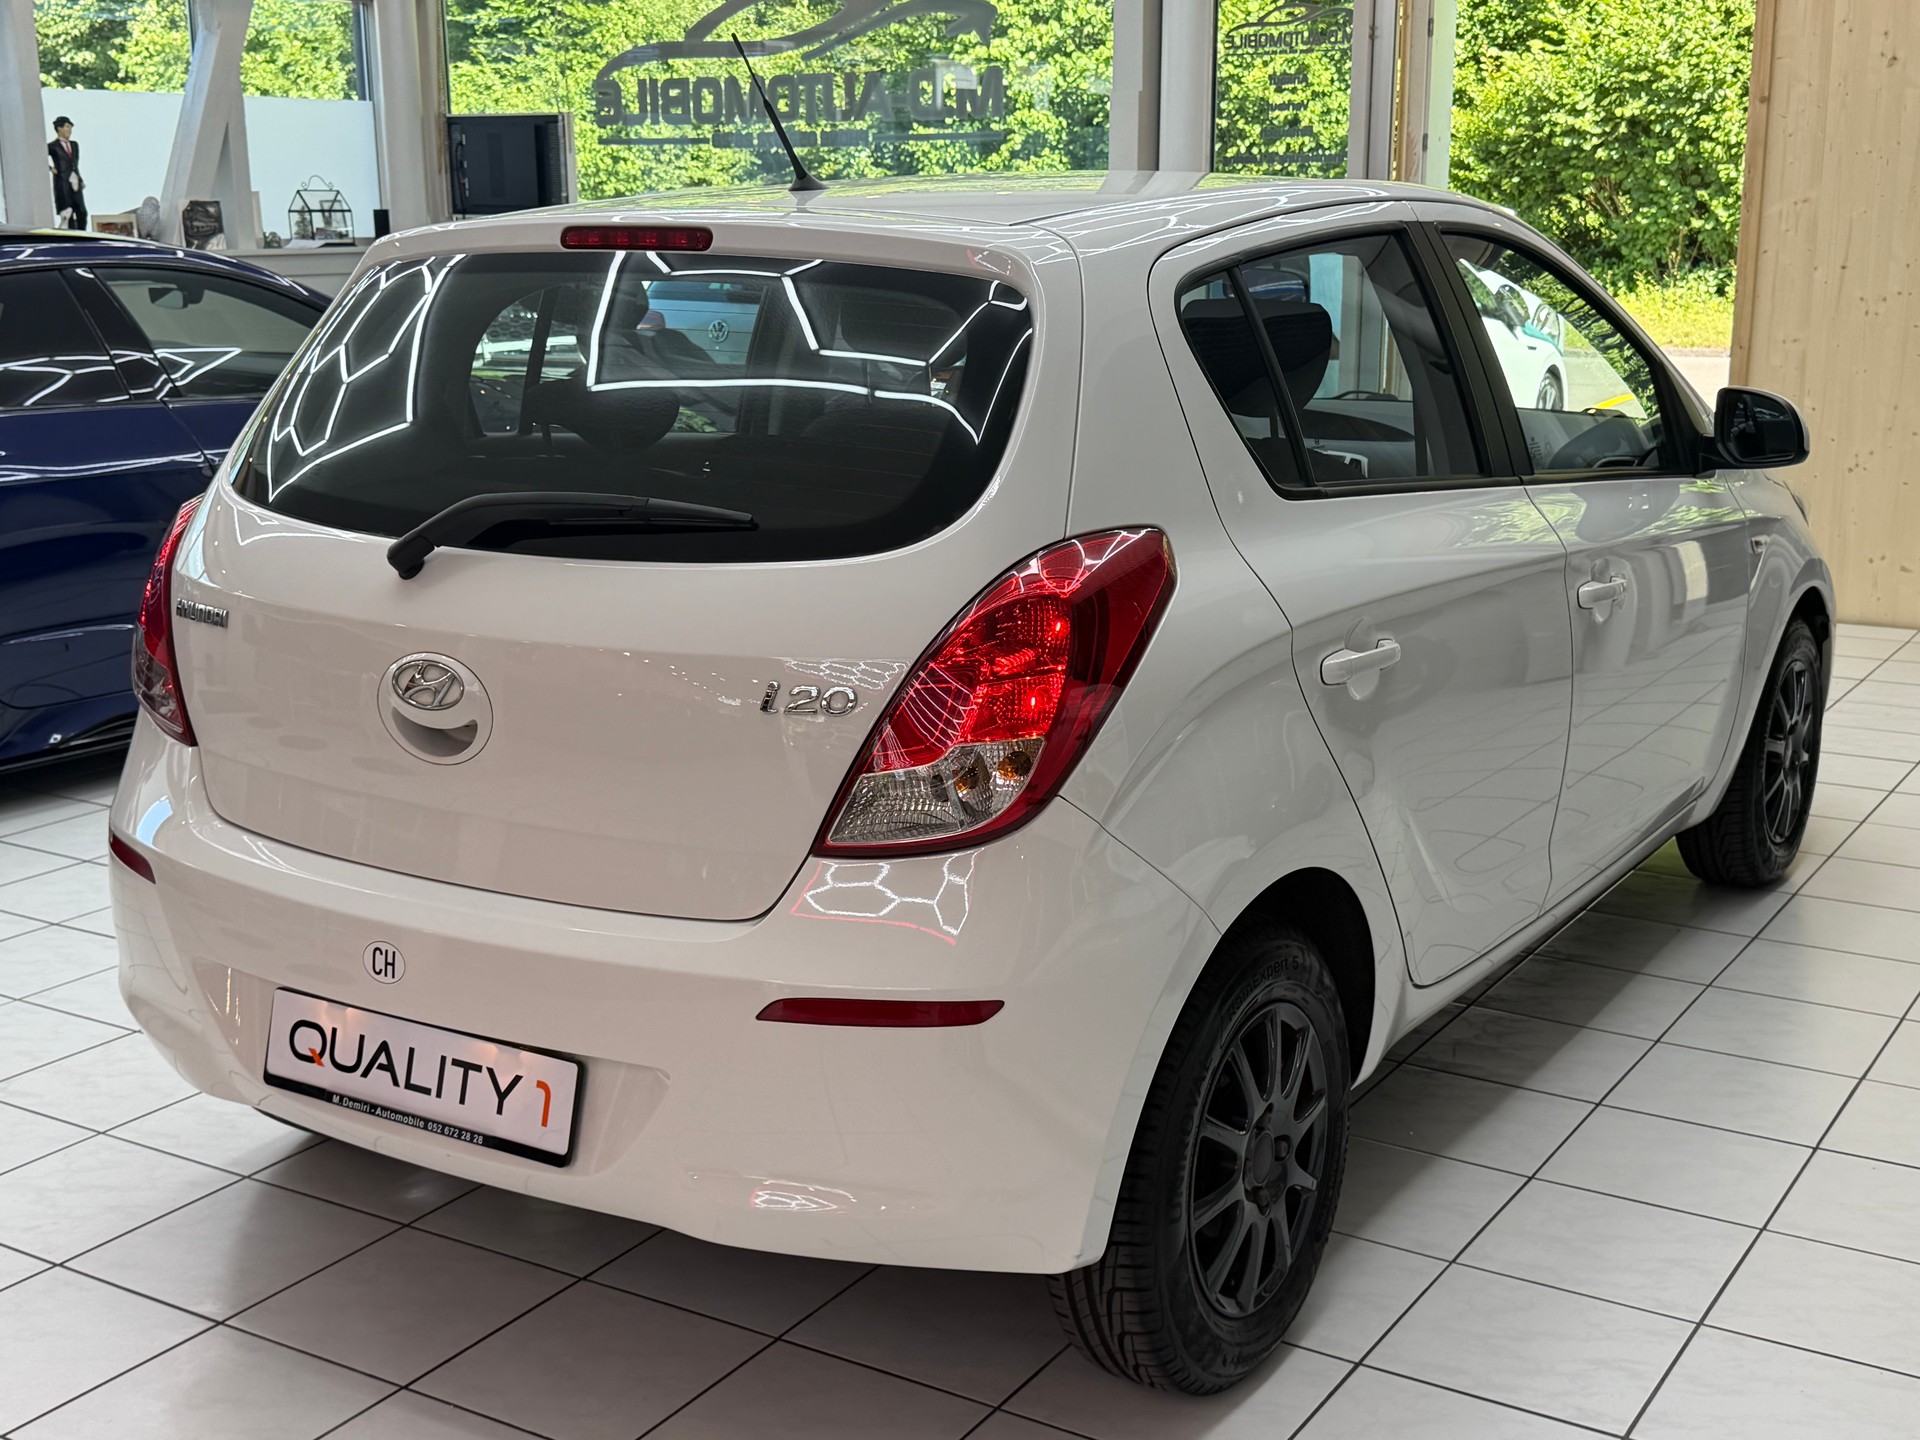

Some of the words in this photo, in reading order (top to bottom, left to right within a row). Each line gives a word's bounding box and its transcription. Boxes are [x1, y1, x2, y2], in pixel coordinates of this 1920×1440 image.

[176, 598, 229, 629] HYUNDAI
[760, 680, 858, 717] i20
[372, 946, 396, 980] CH
[289, 1019, 524, 1116] QUALITY
[375, 1106, 425, 1129] Automobile
[427, 1121, 443, 1133] 052
[444, 1126, 459, 1138] 672
[461, 1130, 471, 1141] 28
[472, 1134, 484, 1145] 28
